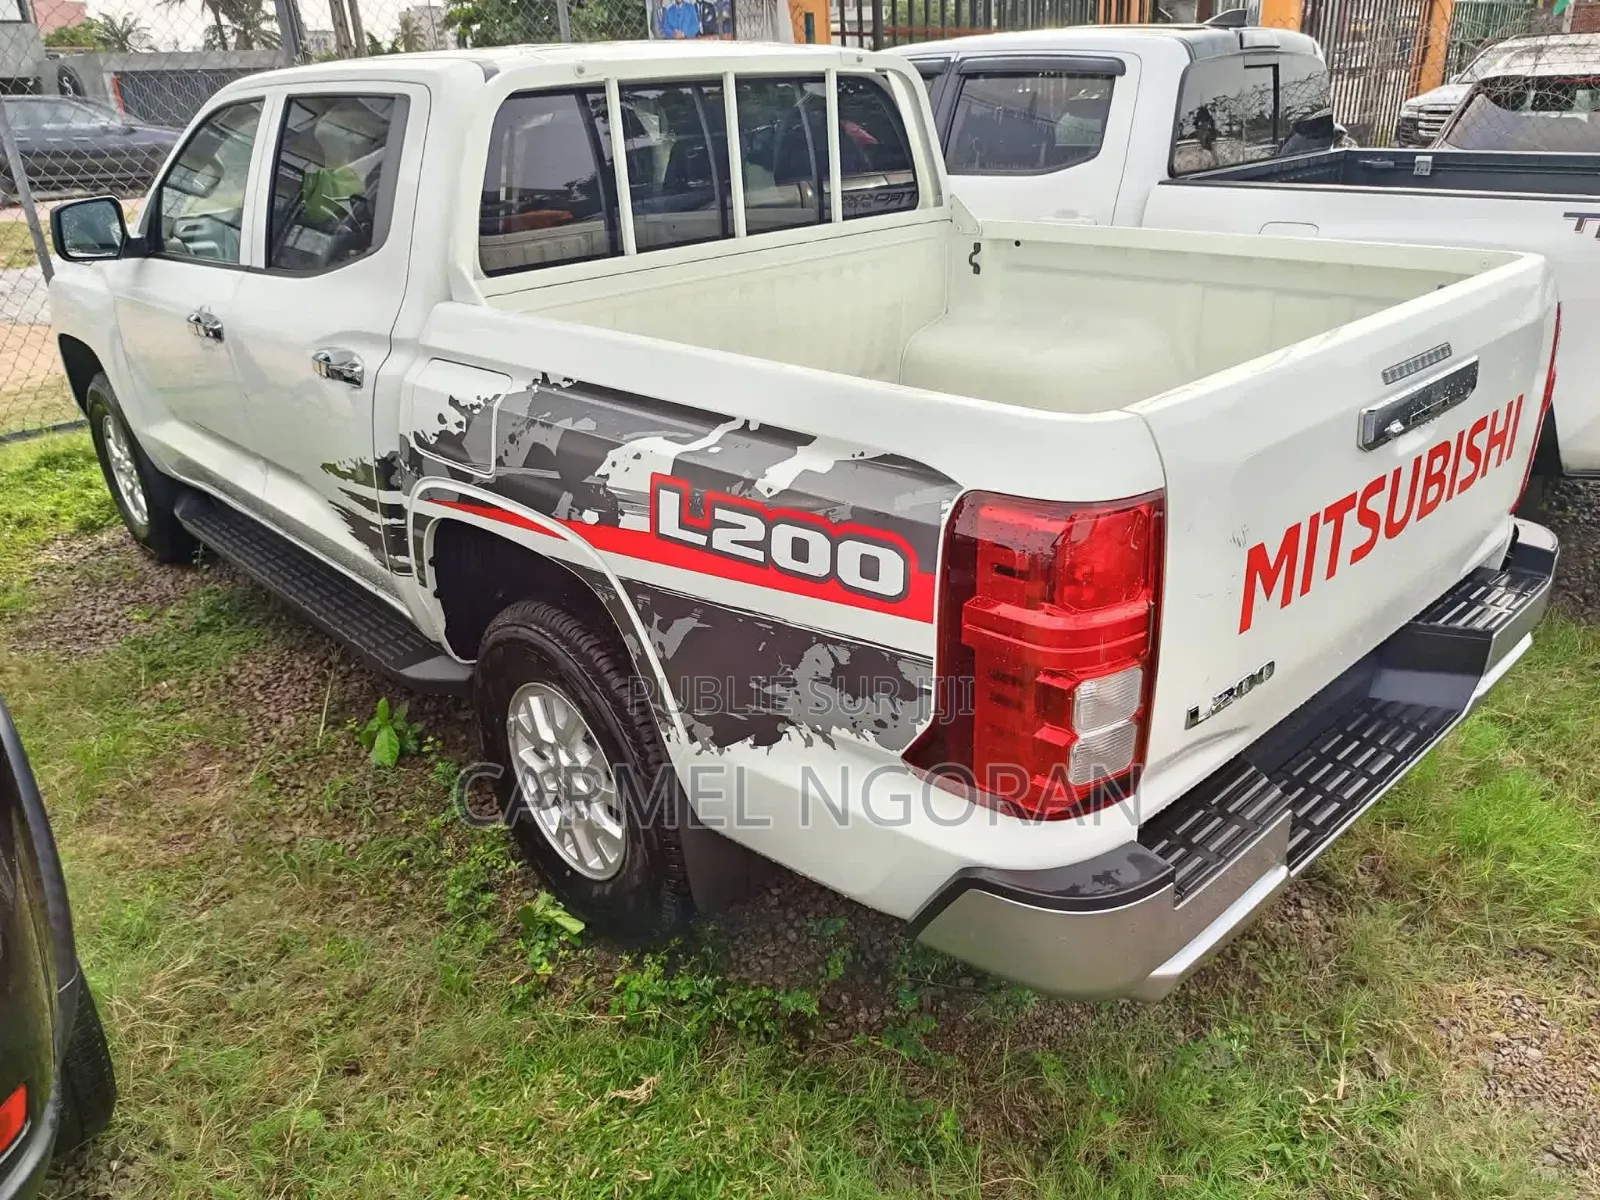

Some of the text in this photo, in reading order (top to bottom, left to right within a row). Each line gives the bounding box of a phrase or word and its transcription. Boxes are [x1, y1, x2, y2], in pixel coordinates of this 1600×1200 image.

[1562, 211, 1600, 241] T
[657, 486, 906, 598] L200
[1239, 394, 1524, 635] MITSUBISHI
[1184, 659, 1275, 731] L200
